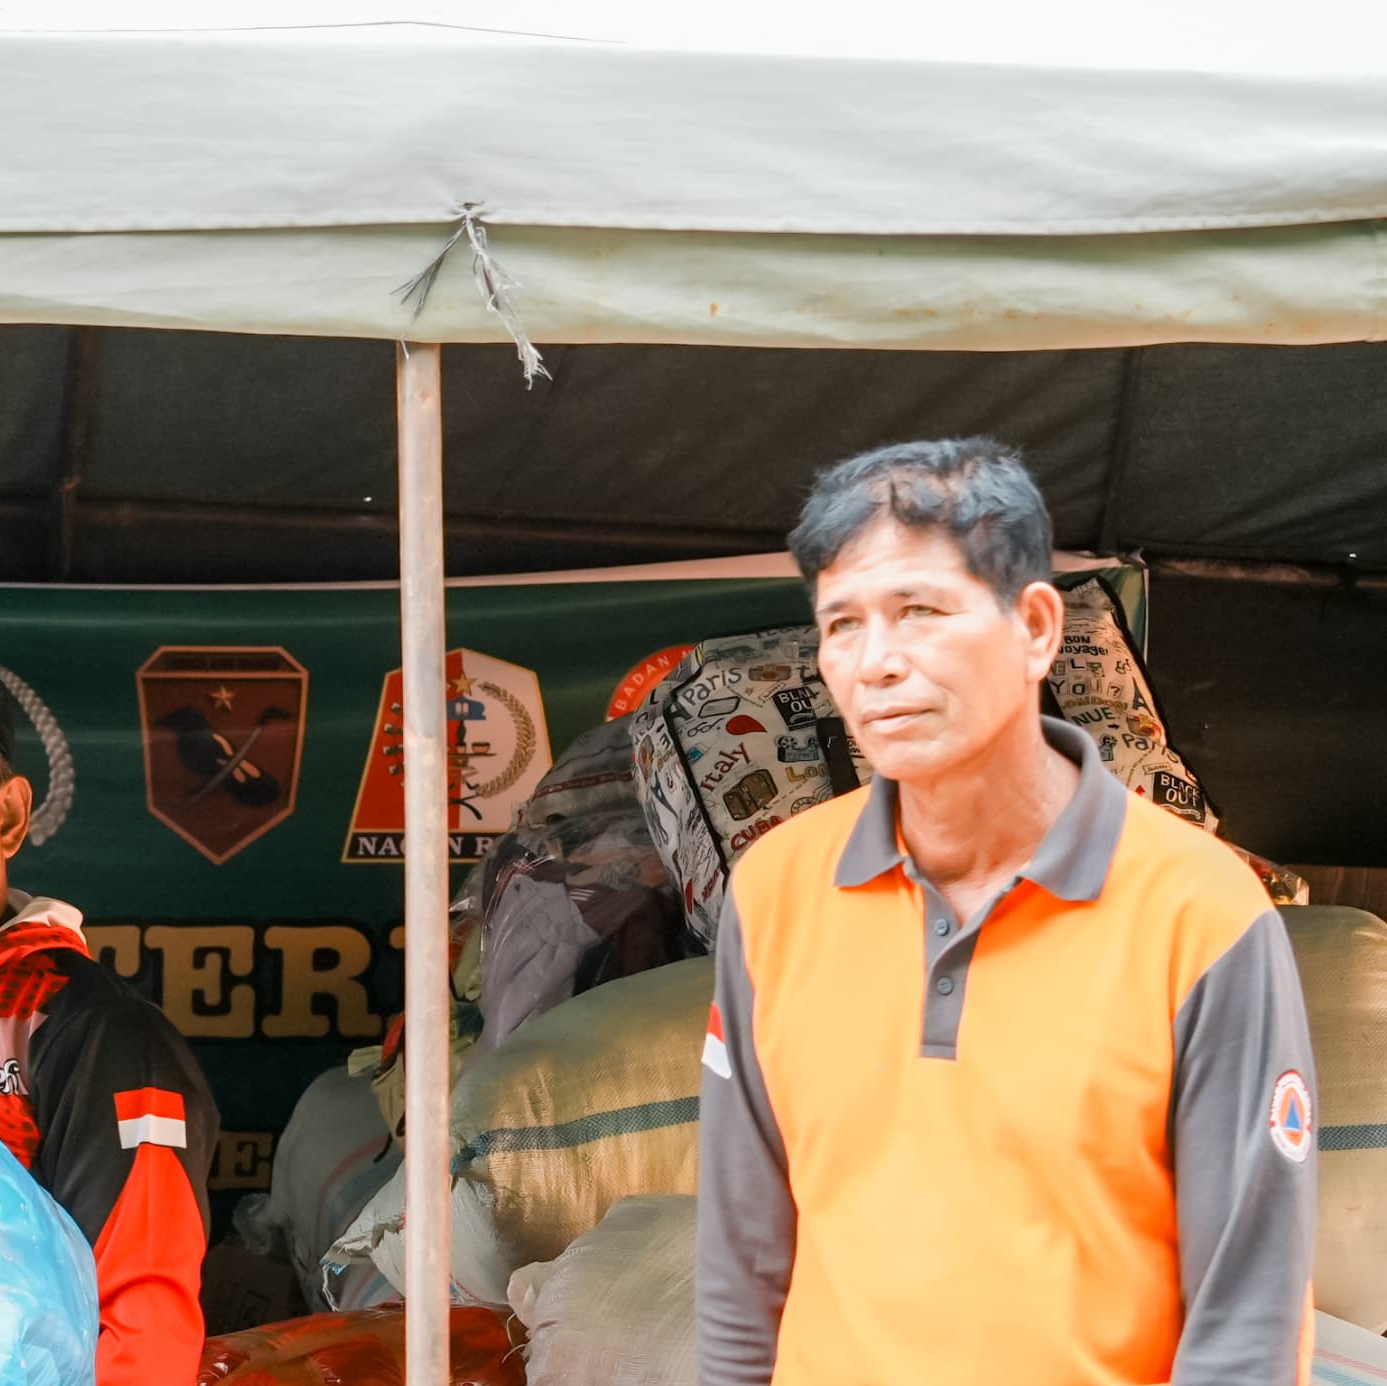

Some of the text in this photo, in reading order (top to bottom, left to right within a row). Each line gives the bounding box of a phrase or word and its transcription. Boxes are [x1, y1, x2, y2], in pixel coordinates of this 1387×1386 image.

[1064, 636, 1090, 644] BON
[682, 668, 742, 706] Paris
[701, 742, 750, 792] Italy
[1160, 774, 1199, 799] BLACK
[1166, 789, 1198, 806] OUT
